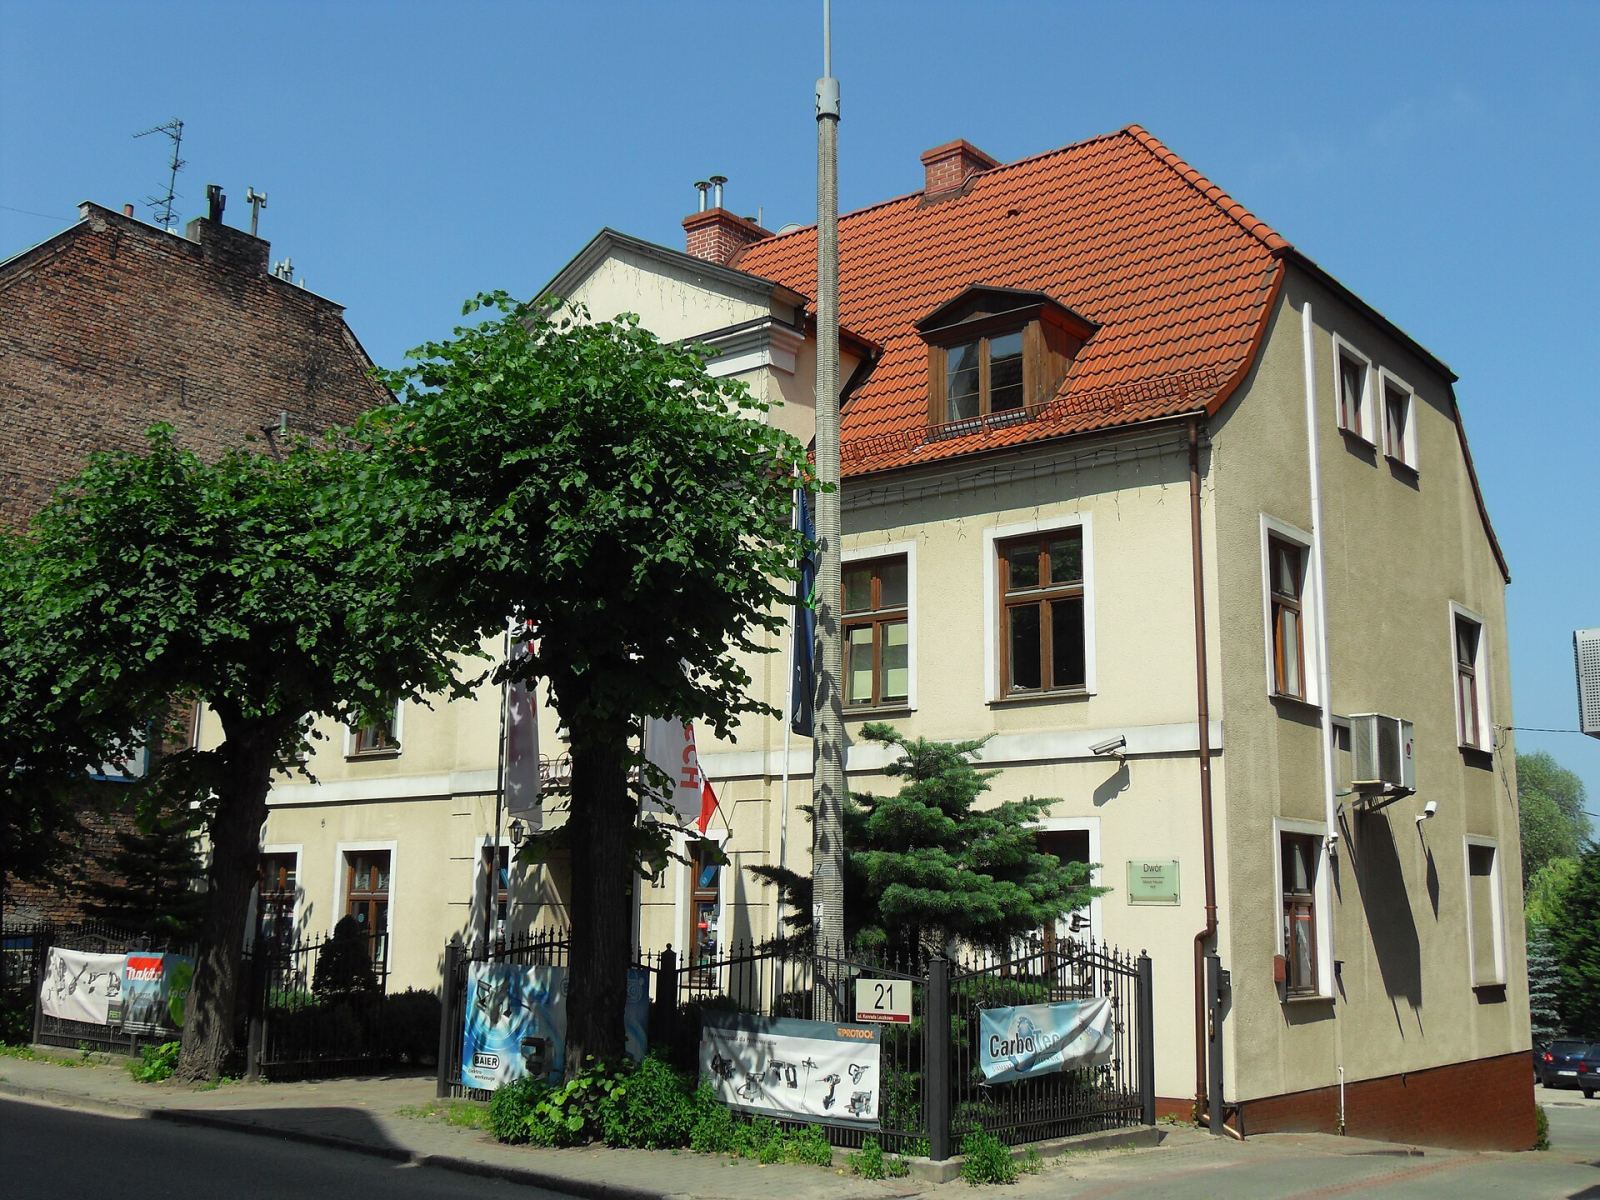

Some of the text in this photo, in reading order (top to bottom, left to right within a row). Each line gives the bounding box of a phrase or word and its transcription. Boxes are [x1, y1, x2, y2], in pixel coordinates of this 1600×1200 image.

[1143, 863, 1162, 873] Dwór
[874, 983, 893, 1010] 21
[841, 1028, 875, 1039] PROTOOL
[474, 1056, 498, 1066] BAIER
